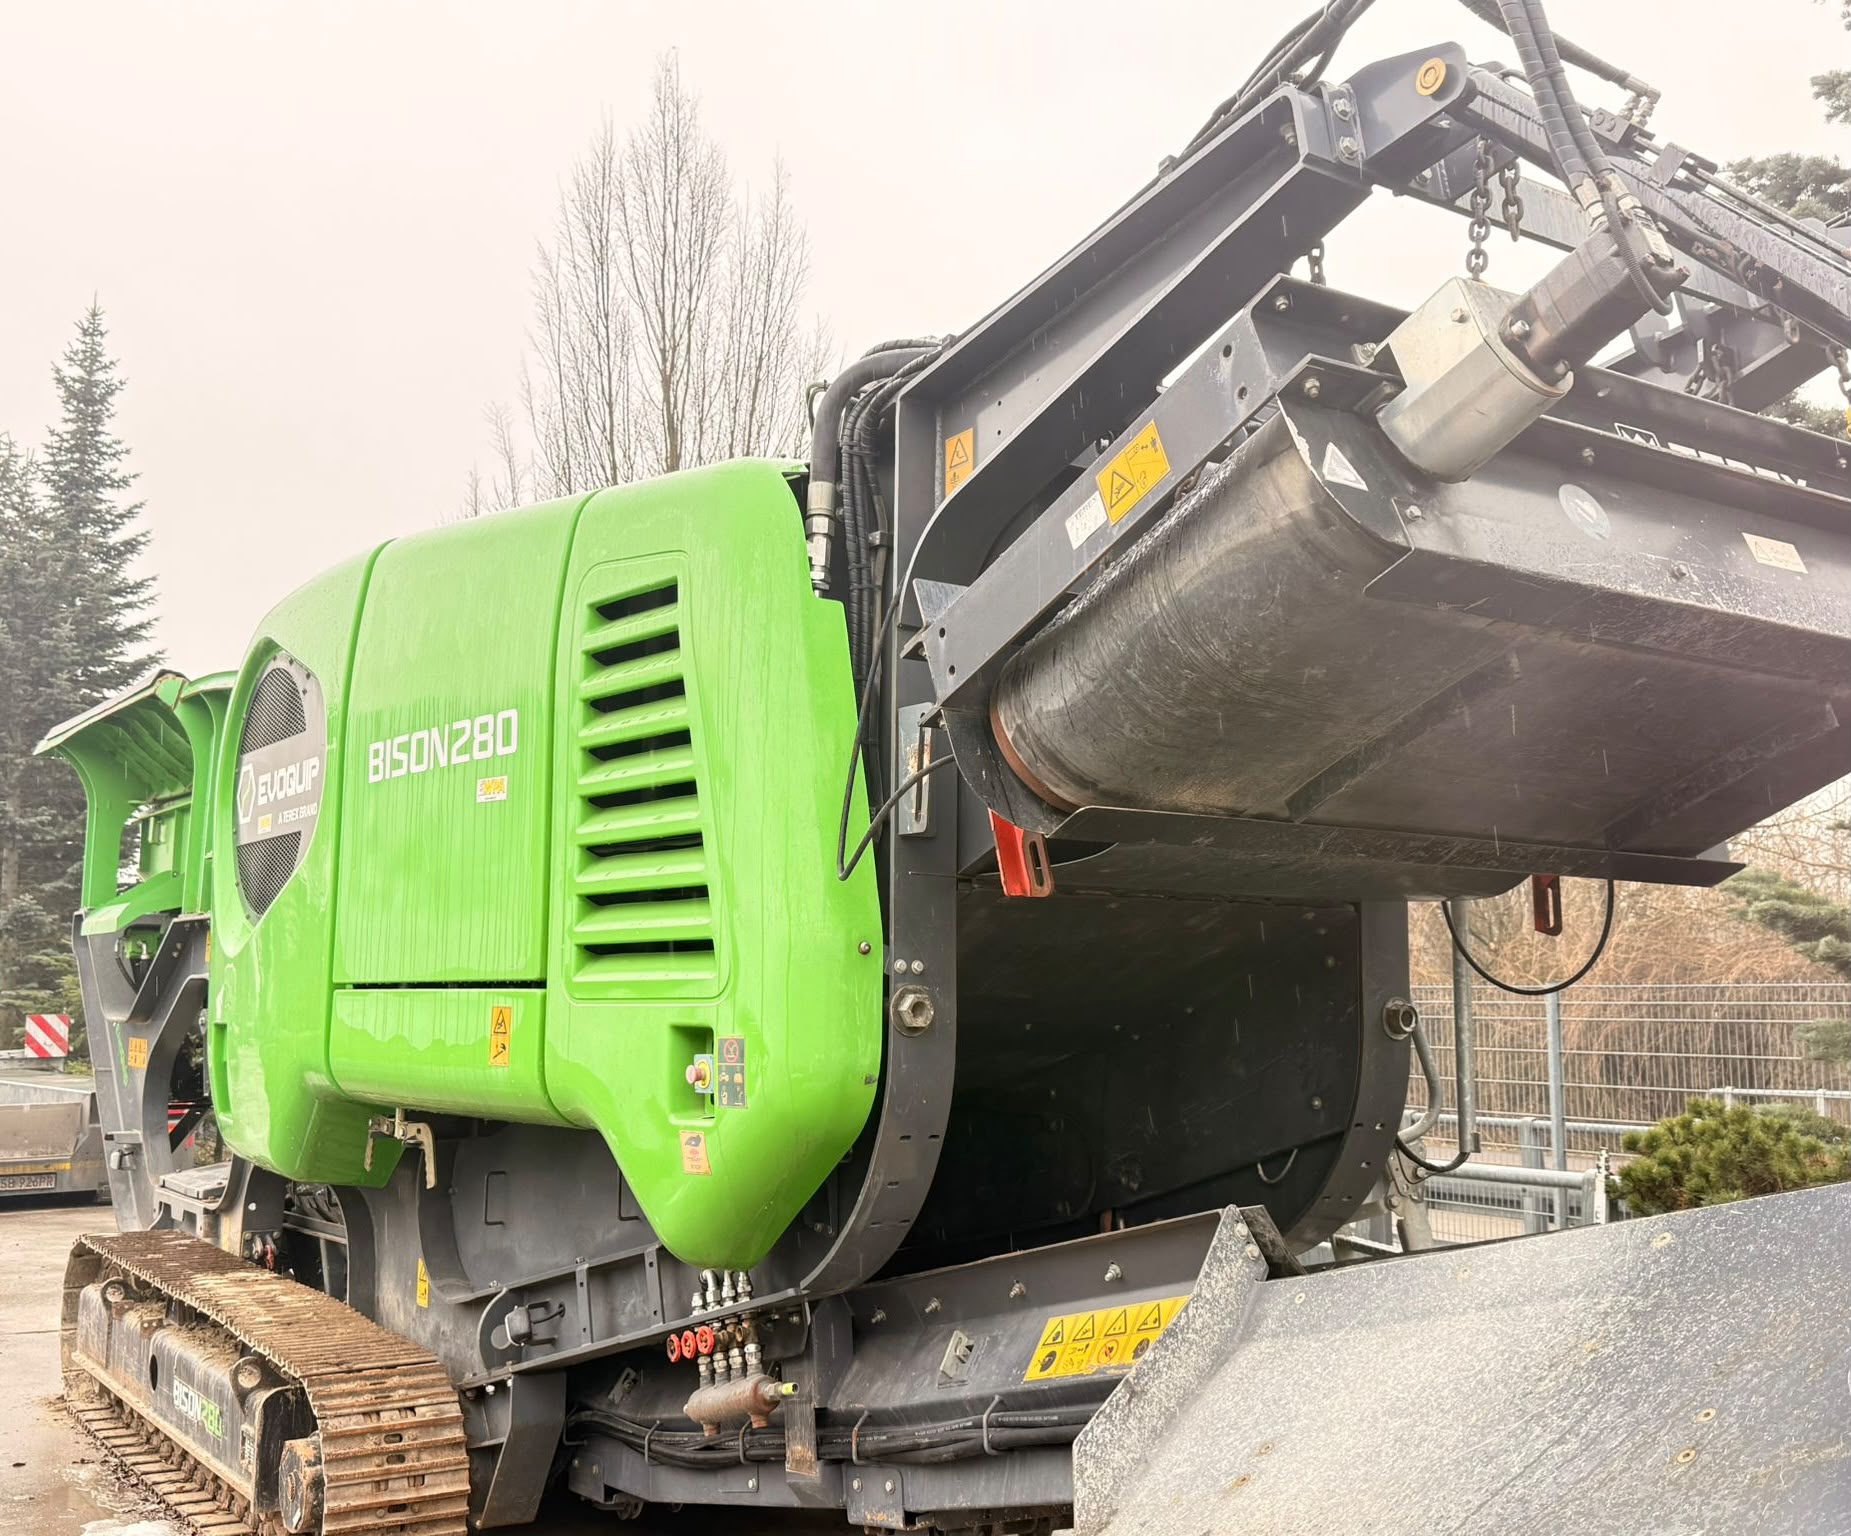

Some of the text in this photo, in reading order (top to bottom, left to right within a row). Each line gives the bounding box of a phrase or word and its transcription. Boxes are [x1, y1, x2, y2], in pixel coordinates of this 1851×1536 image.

[368, 708, 518, 784] BISON280
[257, 756, 320, 806] EVOQUIP
[277, 812, 283, 825] A
[282, 807, 299, 823] TEREX
[299, 802, 318, 819] BRAND
